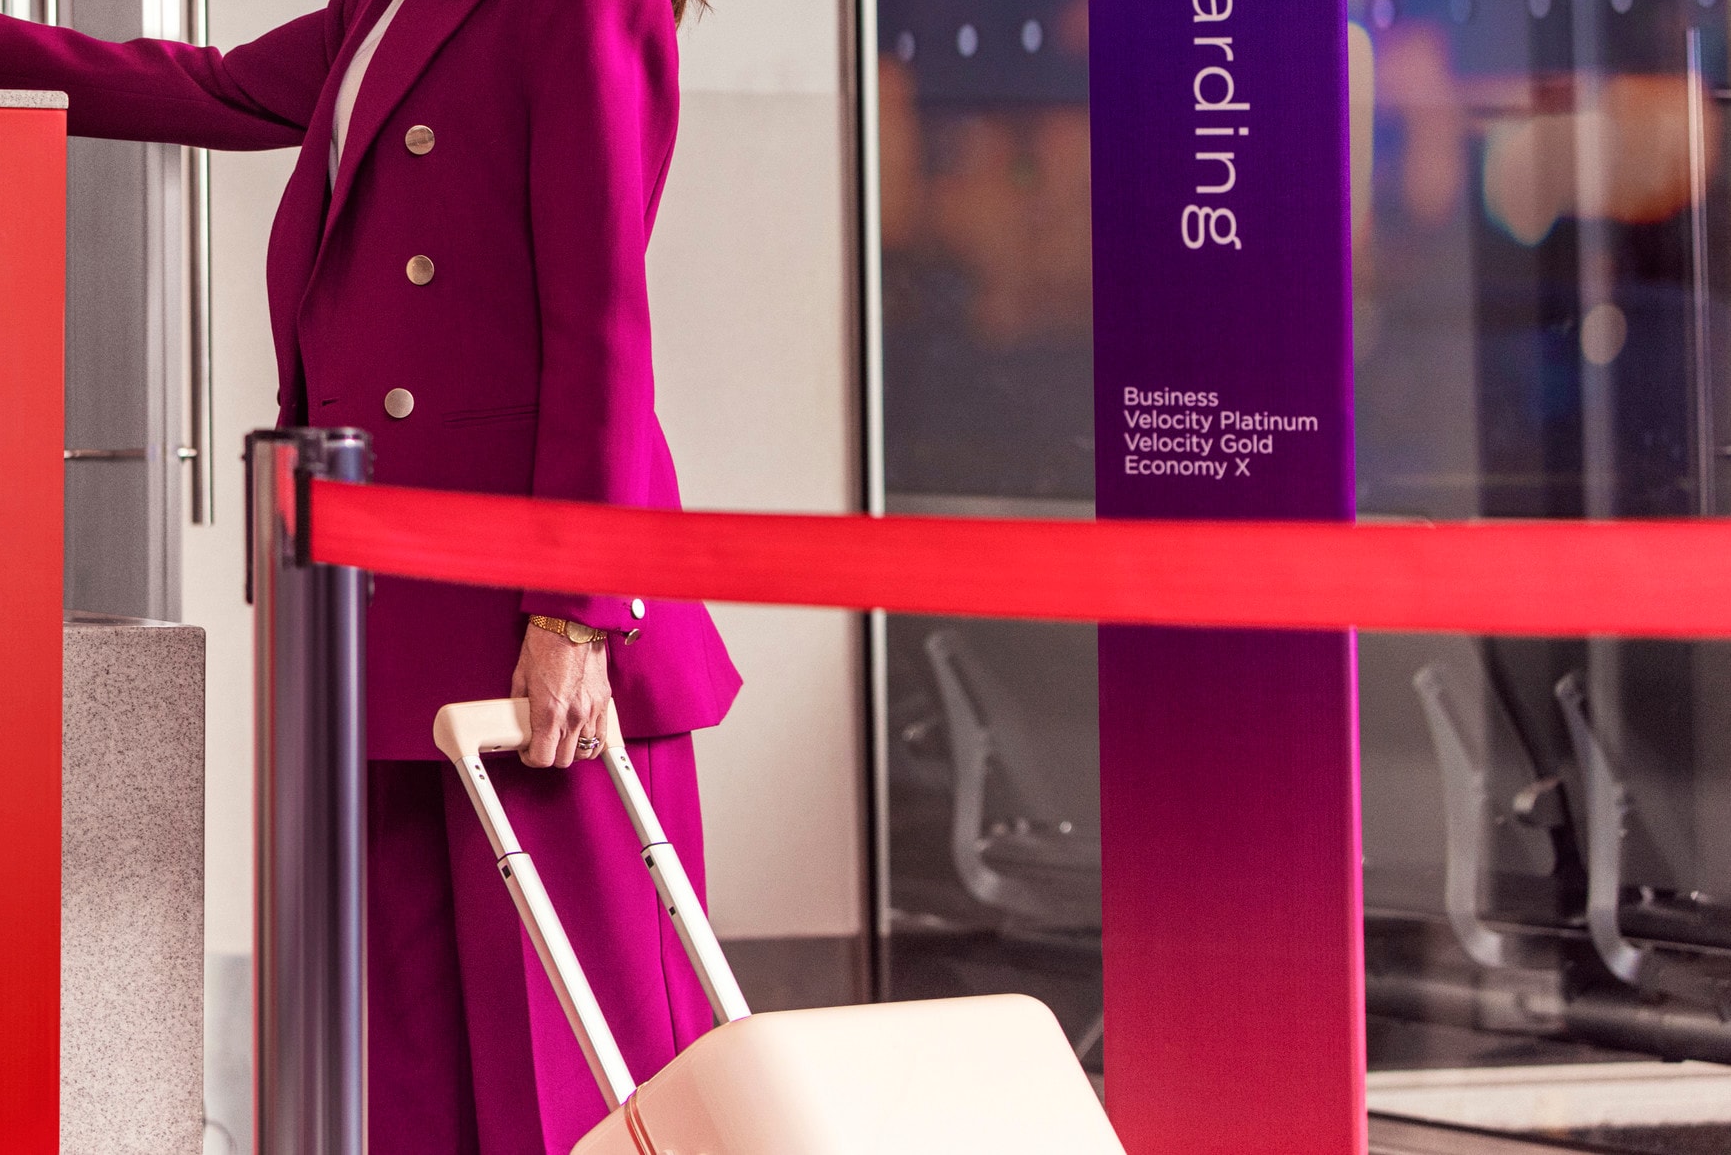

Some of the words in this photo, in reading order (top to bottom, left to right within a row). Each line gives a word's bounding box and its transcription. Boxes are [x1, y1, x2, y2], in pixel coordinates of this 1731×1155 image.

[1124, 387, 1218, 407] Business
[1124, 410, 1213, 433] Velocity
[1220, 411, 1318, 431] Platinum
[1124, 432, 1213, 456] Velocity
[1220, 434, 1273, 454] Gold
[1125, 455, 1228, 480] Economy
[1235, 458, 1251, 477] X
